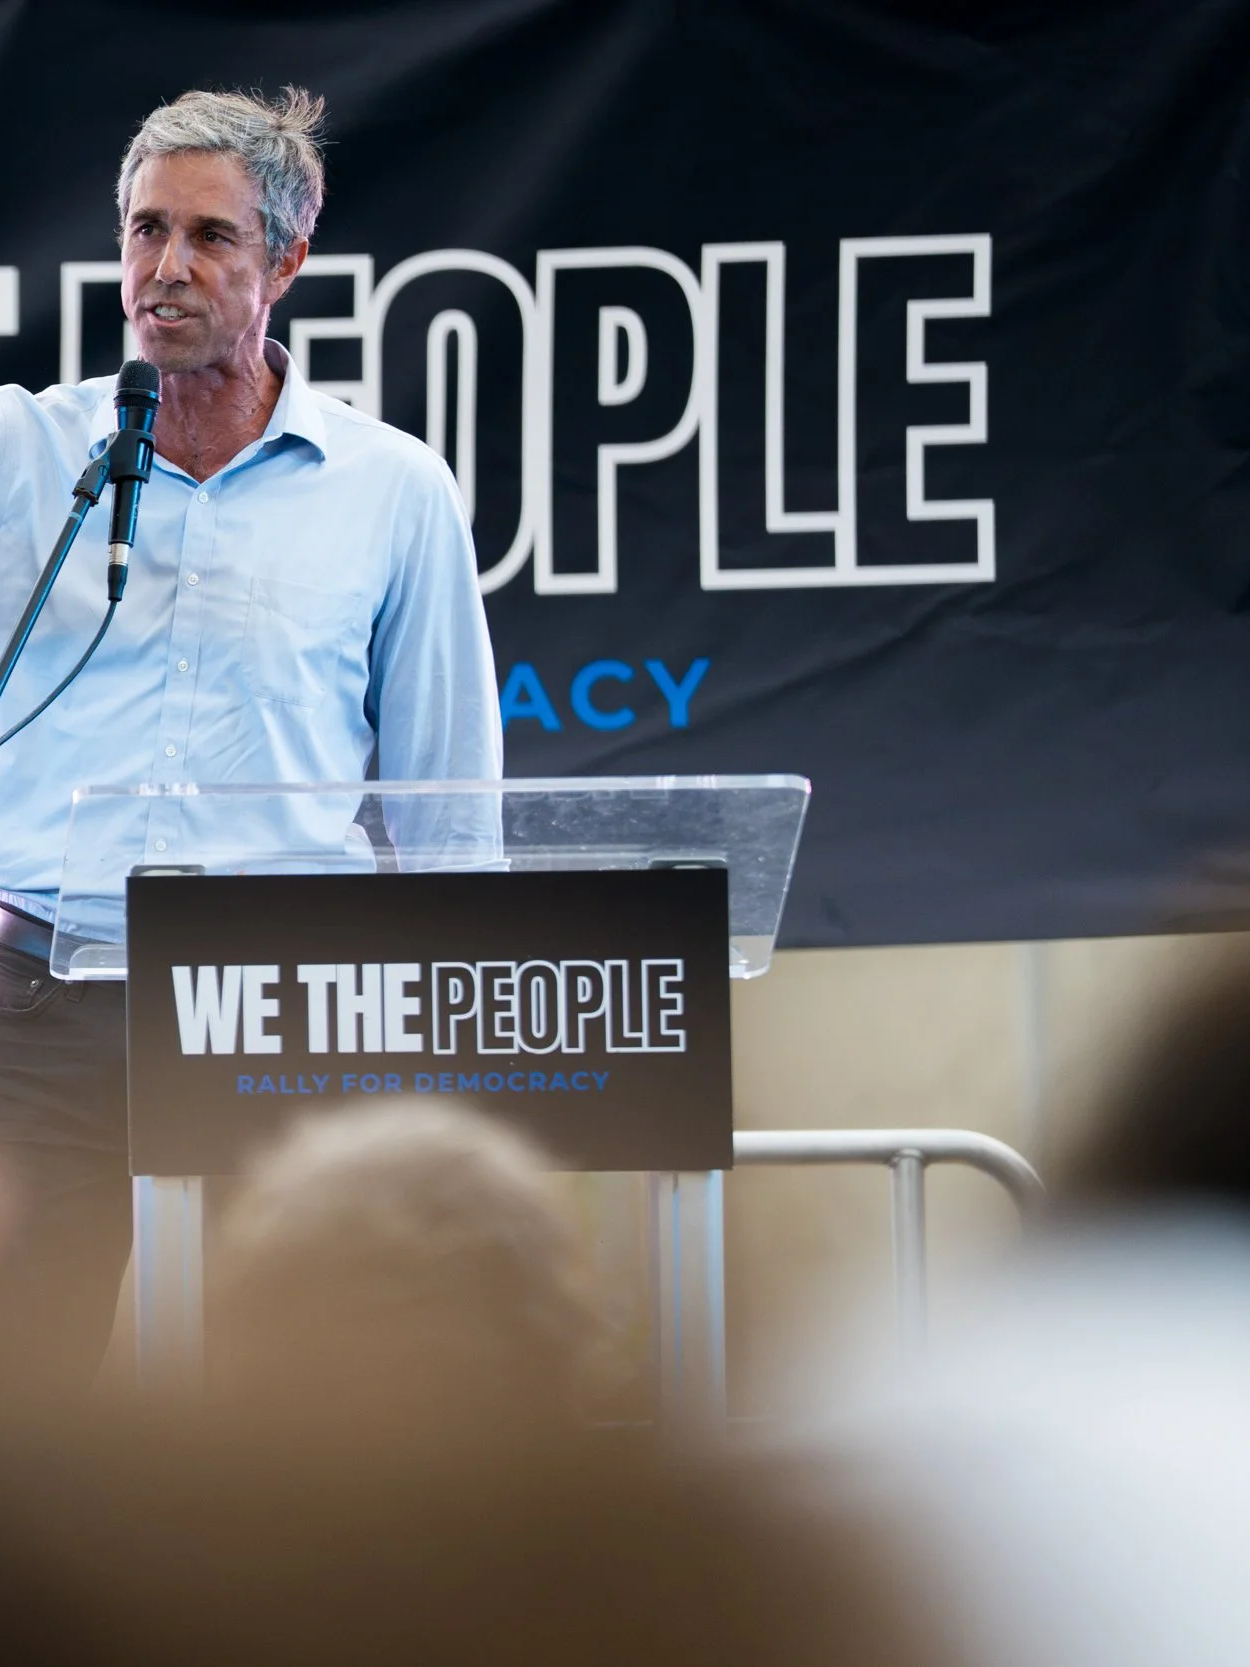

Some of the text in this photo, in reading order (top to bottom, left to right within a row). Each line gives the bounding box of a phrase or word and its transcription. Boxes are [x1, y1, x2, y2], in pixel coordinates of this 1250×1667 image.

[60, 234, 996, 598] OPLE
[172, 959, 687, 1056] WE THE PEOPLE
[237, 1070, 610, 1095] RALLY FOR DEMOCRACY
